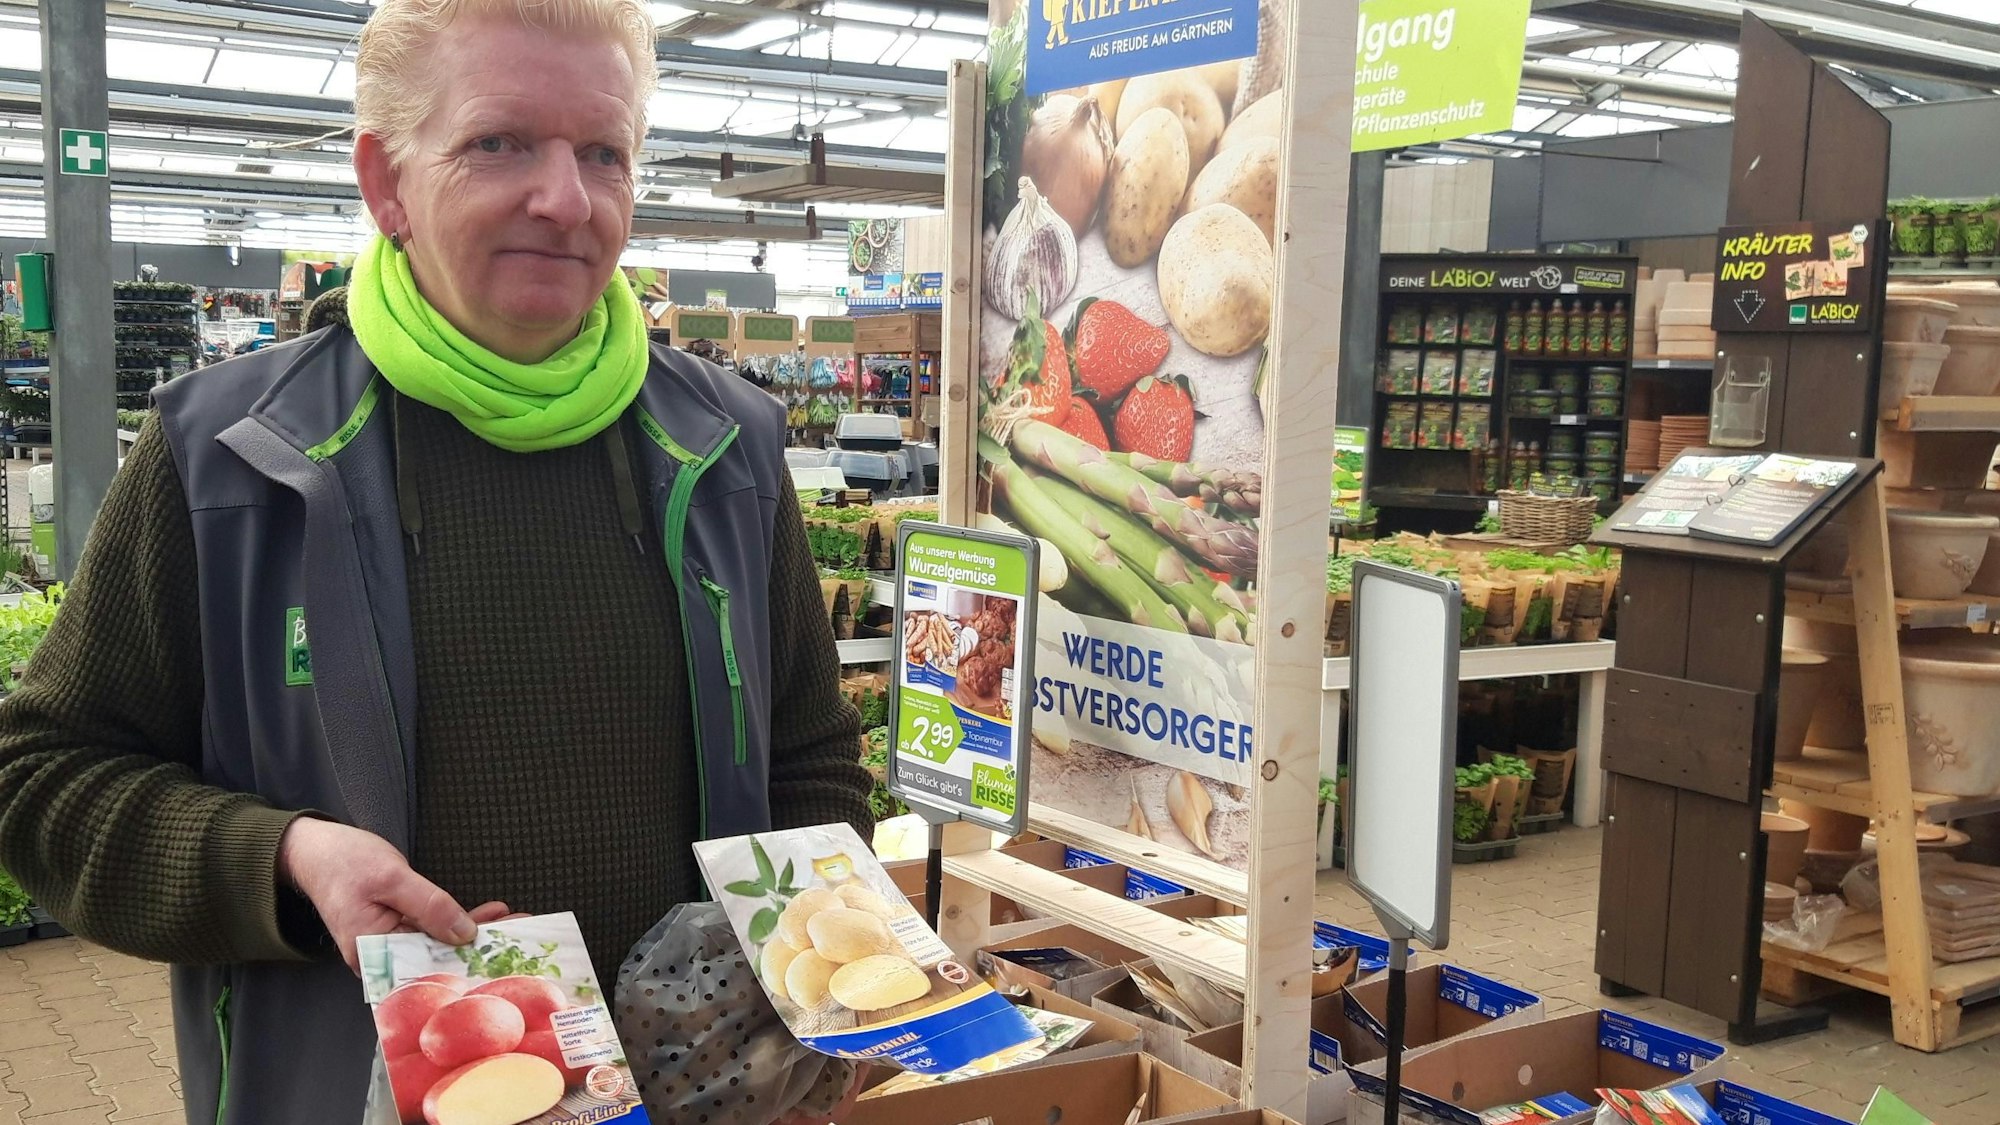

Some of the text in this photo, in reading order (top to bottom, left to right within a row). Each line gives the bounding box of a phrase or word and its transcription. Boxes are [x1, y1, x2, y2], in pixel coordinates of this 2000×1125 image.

[1089, 17, 1233, 59] AUS FREUDE AM GÄRTNERN
[1722, 232, 1813, 258] KRÄUTER
[1389, 276, 1425, 288] DEINE
[1499, 277, 1531, 289] WELT
[1720, 260, 1766, 282] INFO
[338, 424, 359, 443] RISSE
[641, 419, 662, 441] RISSE
[909, 542, 996, 569] Aus unserer Werbung
[908, 556, 997, 586] Wurzelgemüse
[725, 649, 737, 679] RISSE
[1062, 631, 1165, 689] WERDE
[897, 766, 963, 797] Zum Glück gibt's
[976, 769, 1016, 794] Blumen
[976, 785, 1015, 809] RISSE
[554, 1006, 604, 1020] Resistent gegen
[561, 1027, 597, 1039] Mittelfrühe
[563, 1039, 582, 1047] Sorte
[856, 1031, 922, 1058] KIEPENKERL
[568, 1048, 613, 1061] Festkochend
